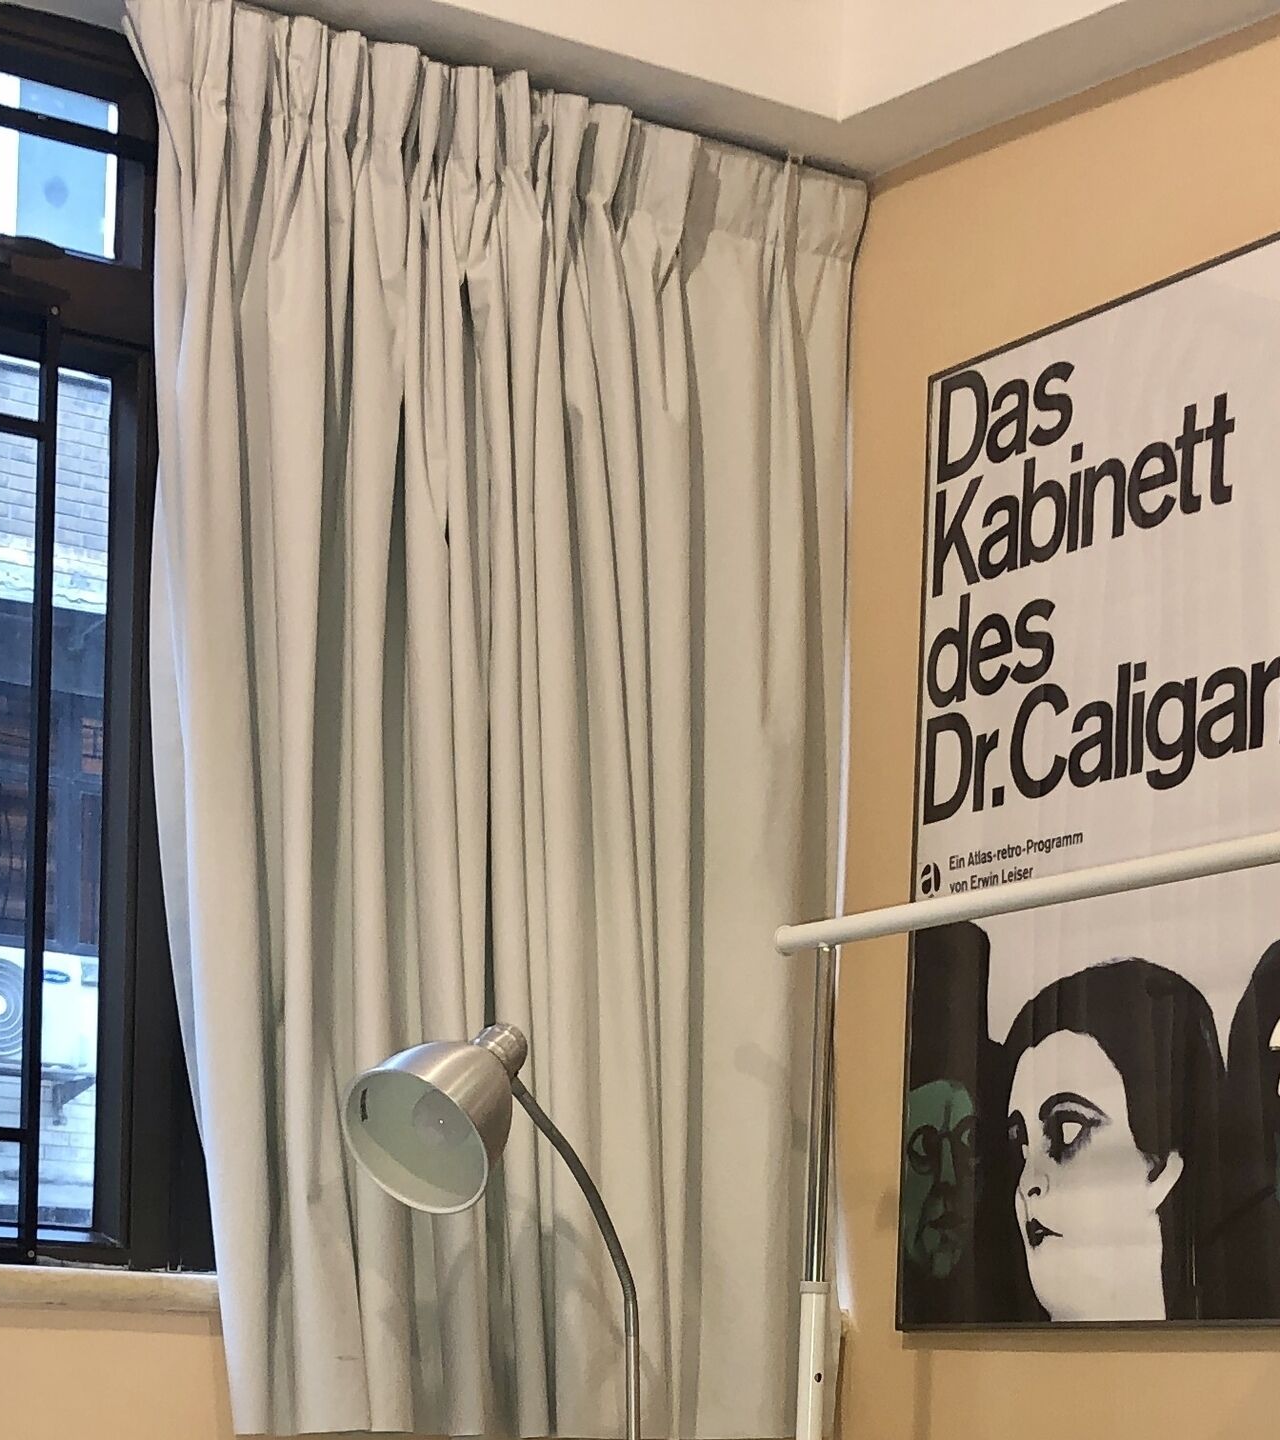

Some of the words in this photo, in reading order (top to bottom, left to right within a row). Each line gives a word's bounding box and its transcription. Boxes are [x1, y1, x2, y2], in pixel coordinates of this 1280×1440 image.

[937, 361, 1075, 484] Das
[932, 393, 1235, 597] Kabinett
[927, 594, 1056, 707] des
[949, 854, 965, 871] Ein
[967, 832, 1083, 868] Atlas-retro-Programm
[949, 879, 968, 894] von
[970, 871, 999, 890] Erwin
[1001, 865, 1034, 885] Leiser
